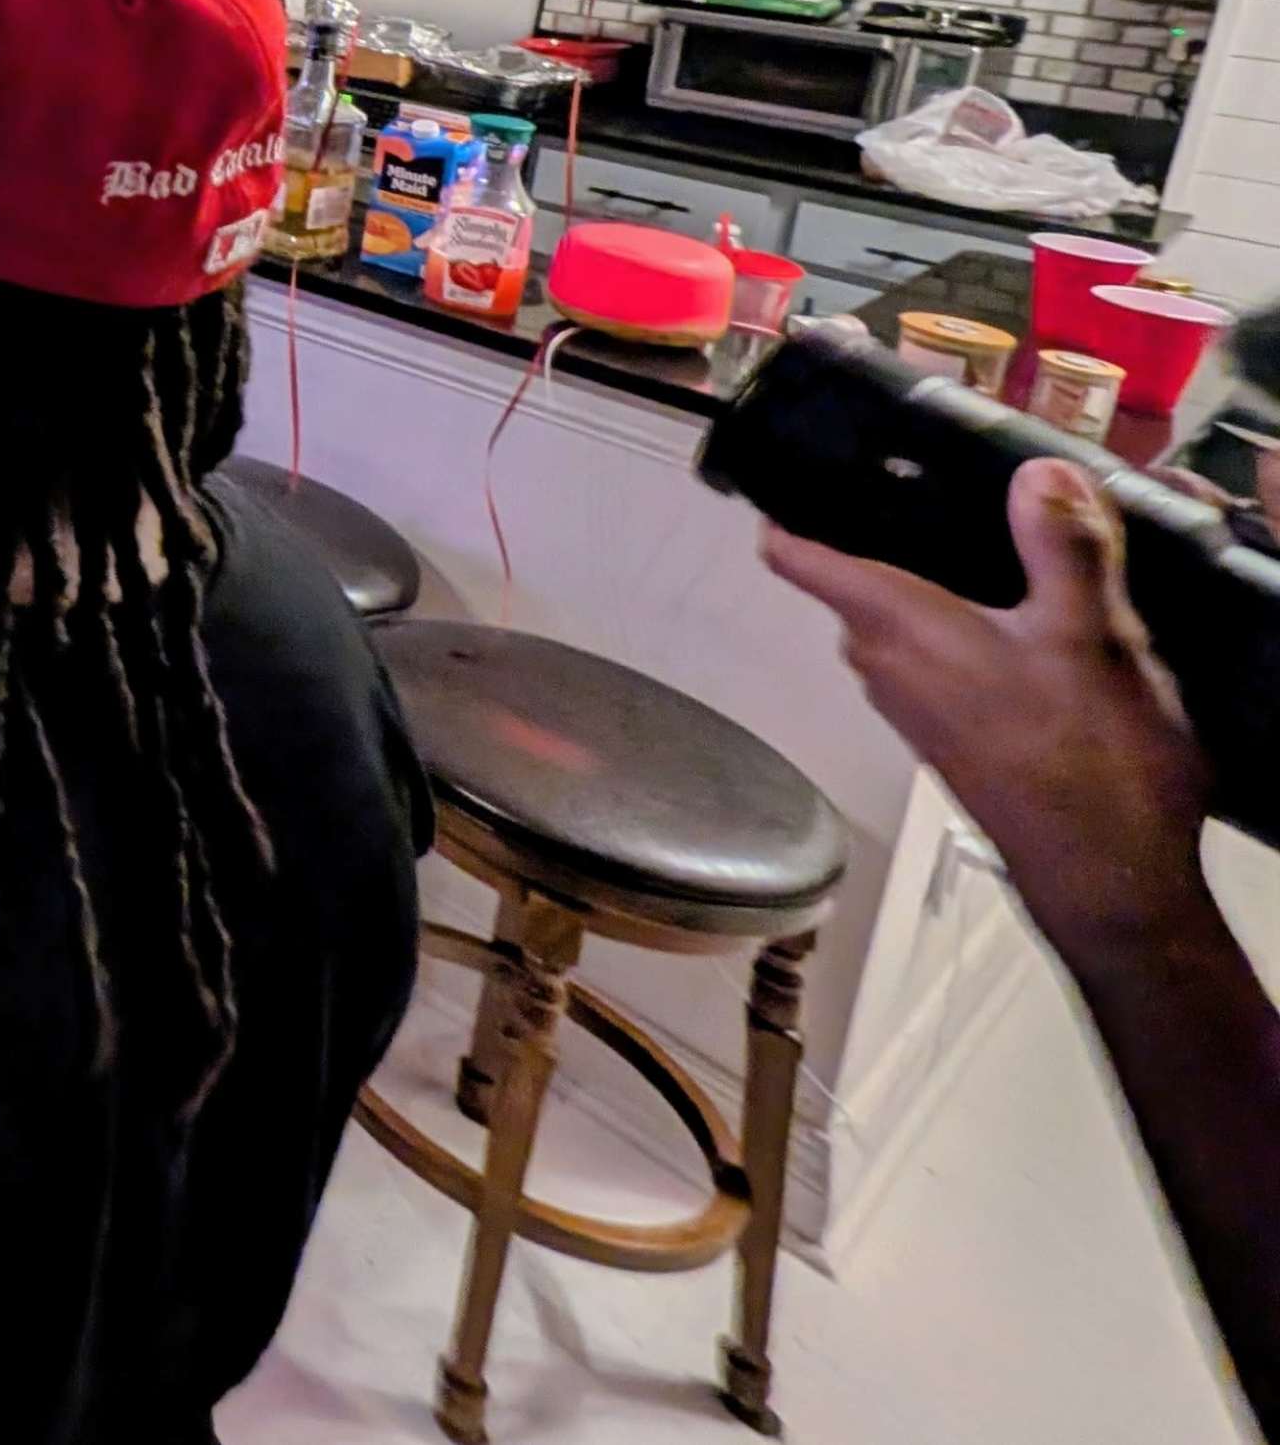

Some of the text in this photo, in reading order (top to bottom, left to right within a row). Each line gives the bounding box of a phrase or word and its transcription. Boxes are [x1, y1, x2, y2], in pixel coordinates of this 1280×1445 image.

[100, 161, 198, 205] Bad
[385, 163, 438, 189] Minute
[391, 177, 430, 198] Maid
